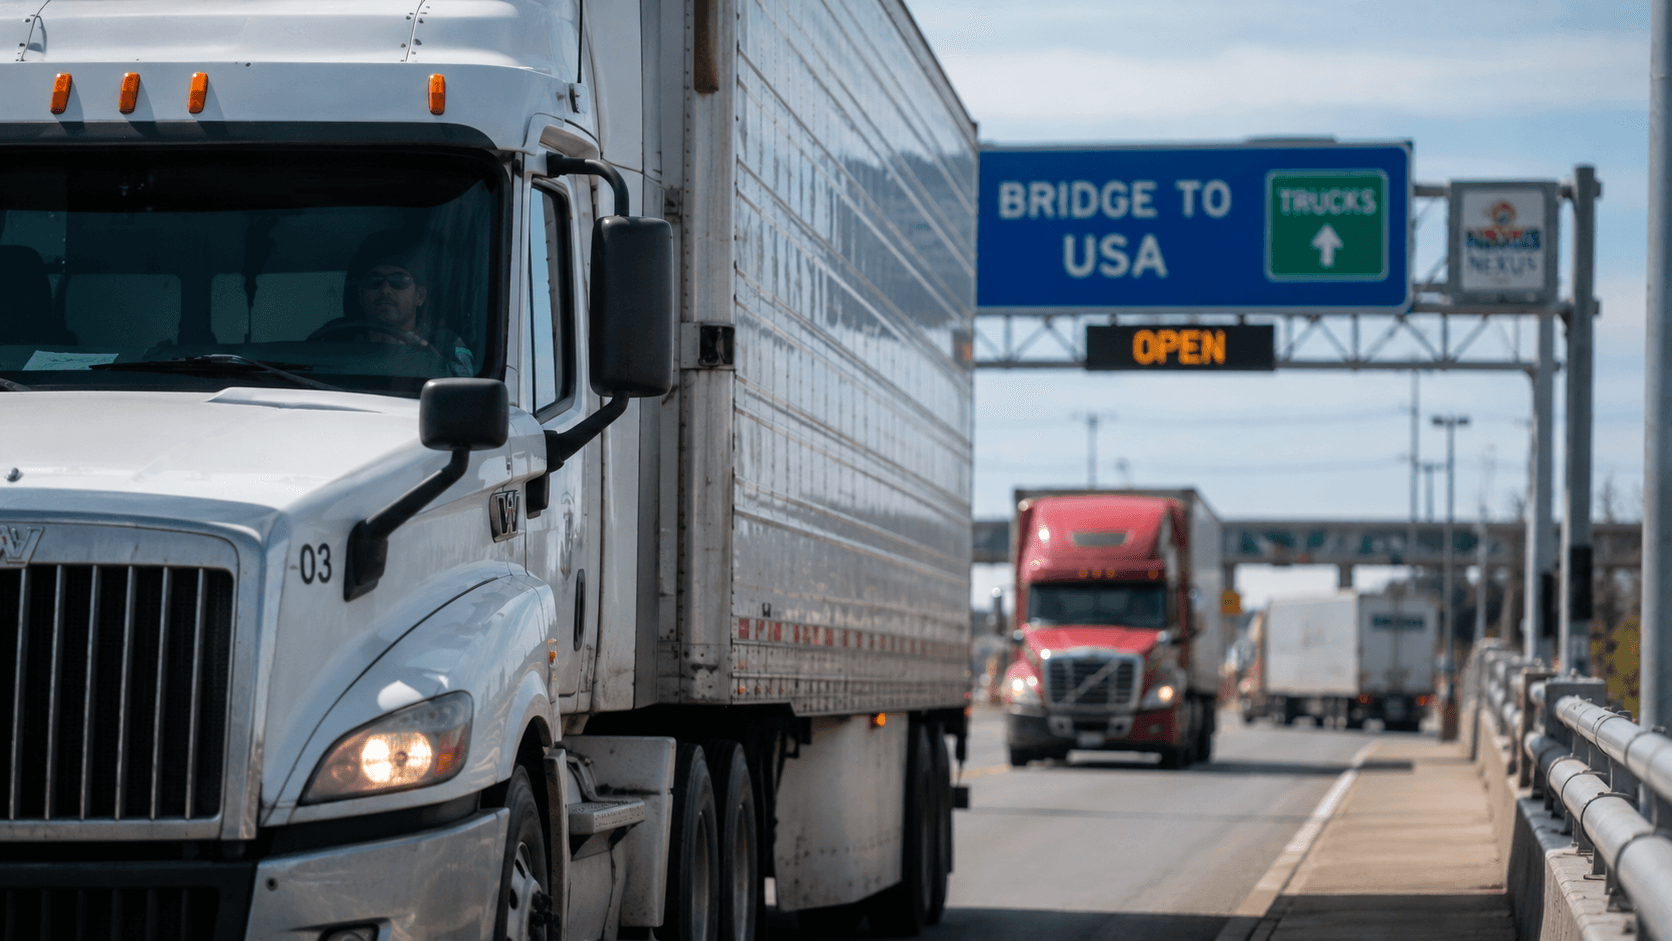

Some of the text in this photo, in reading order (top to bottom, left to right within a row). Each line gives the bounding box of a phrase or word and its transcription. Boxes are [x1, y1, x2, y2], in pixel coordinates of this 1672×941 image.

[998, 180, 1231, 218] BRIDGE TO
[1279, 188, 1377, 214] TRUCKS
[1063, 233, 1167, 278] USA
[1132, 329, 1226, 365] OPEN
[300, 542, 333, 586] 03
